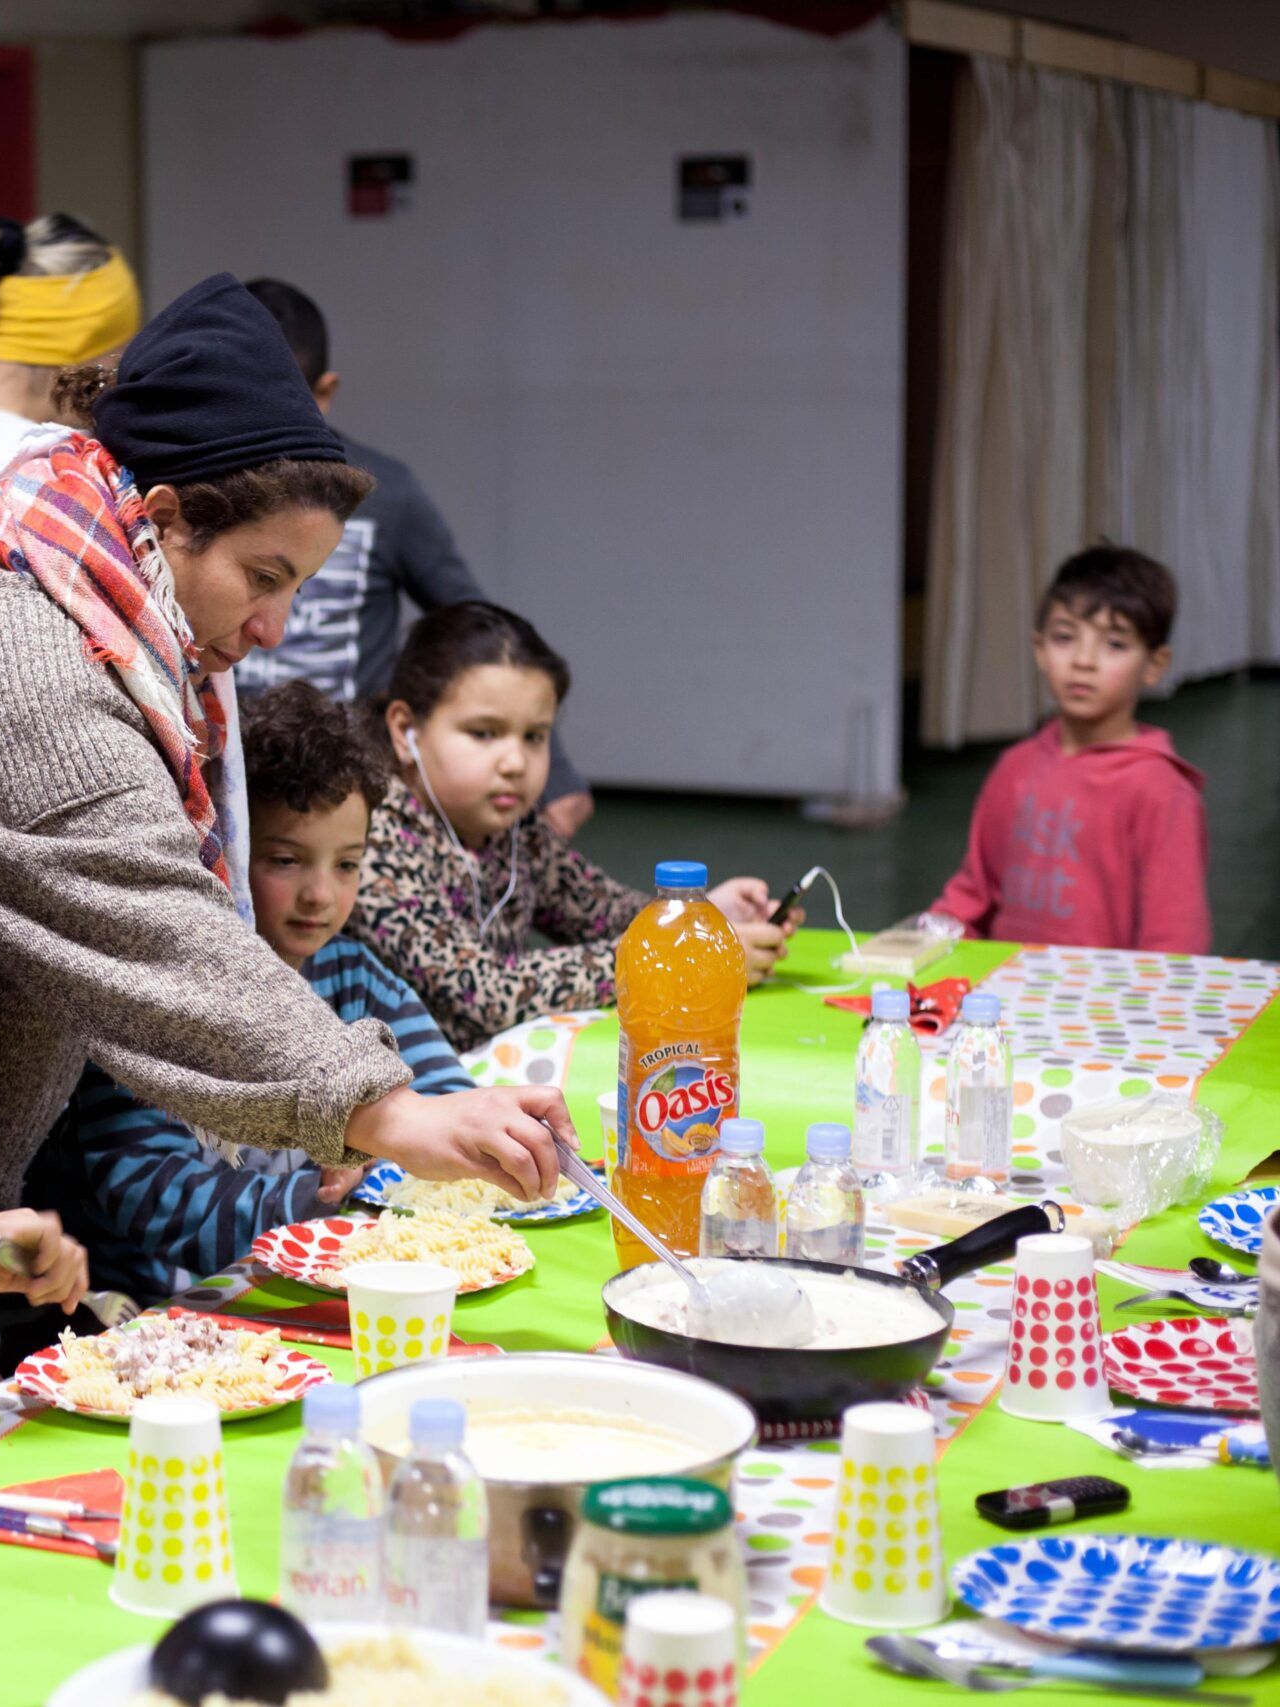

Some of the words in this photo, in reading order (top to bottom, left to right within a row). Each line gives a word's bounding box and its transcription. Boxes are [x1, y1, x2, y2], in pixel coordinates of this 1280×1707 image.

[640, 1043, 700, 1069] TROPICAL
[638, 1068, 734, 1132] Oasis
[291, 1569, 366, 1598] evian
